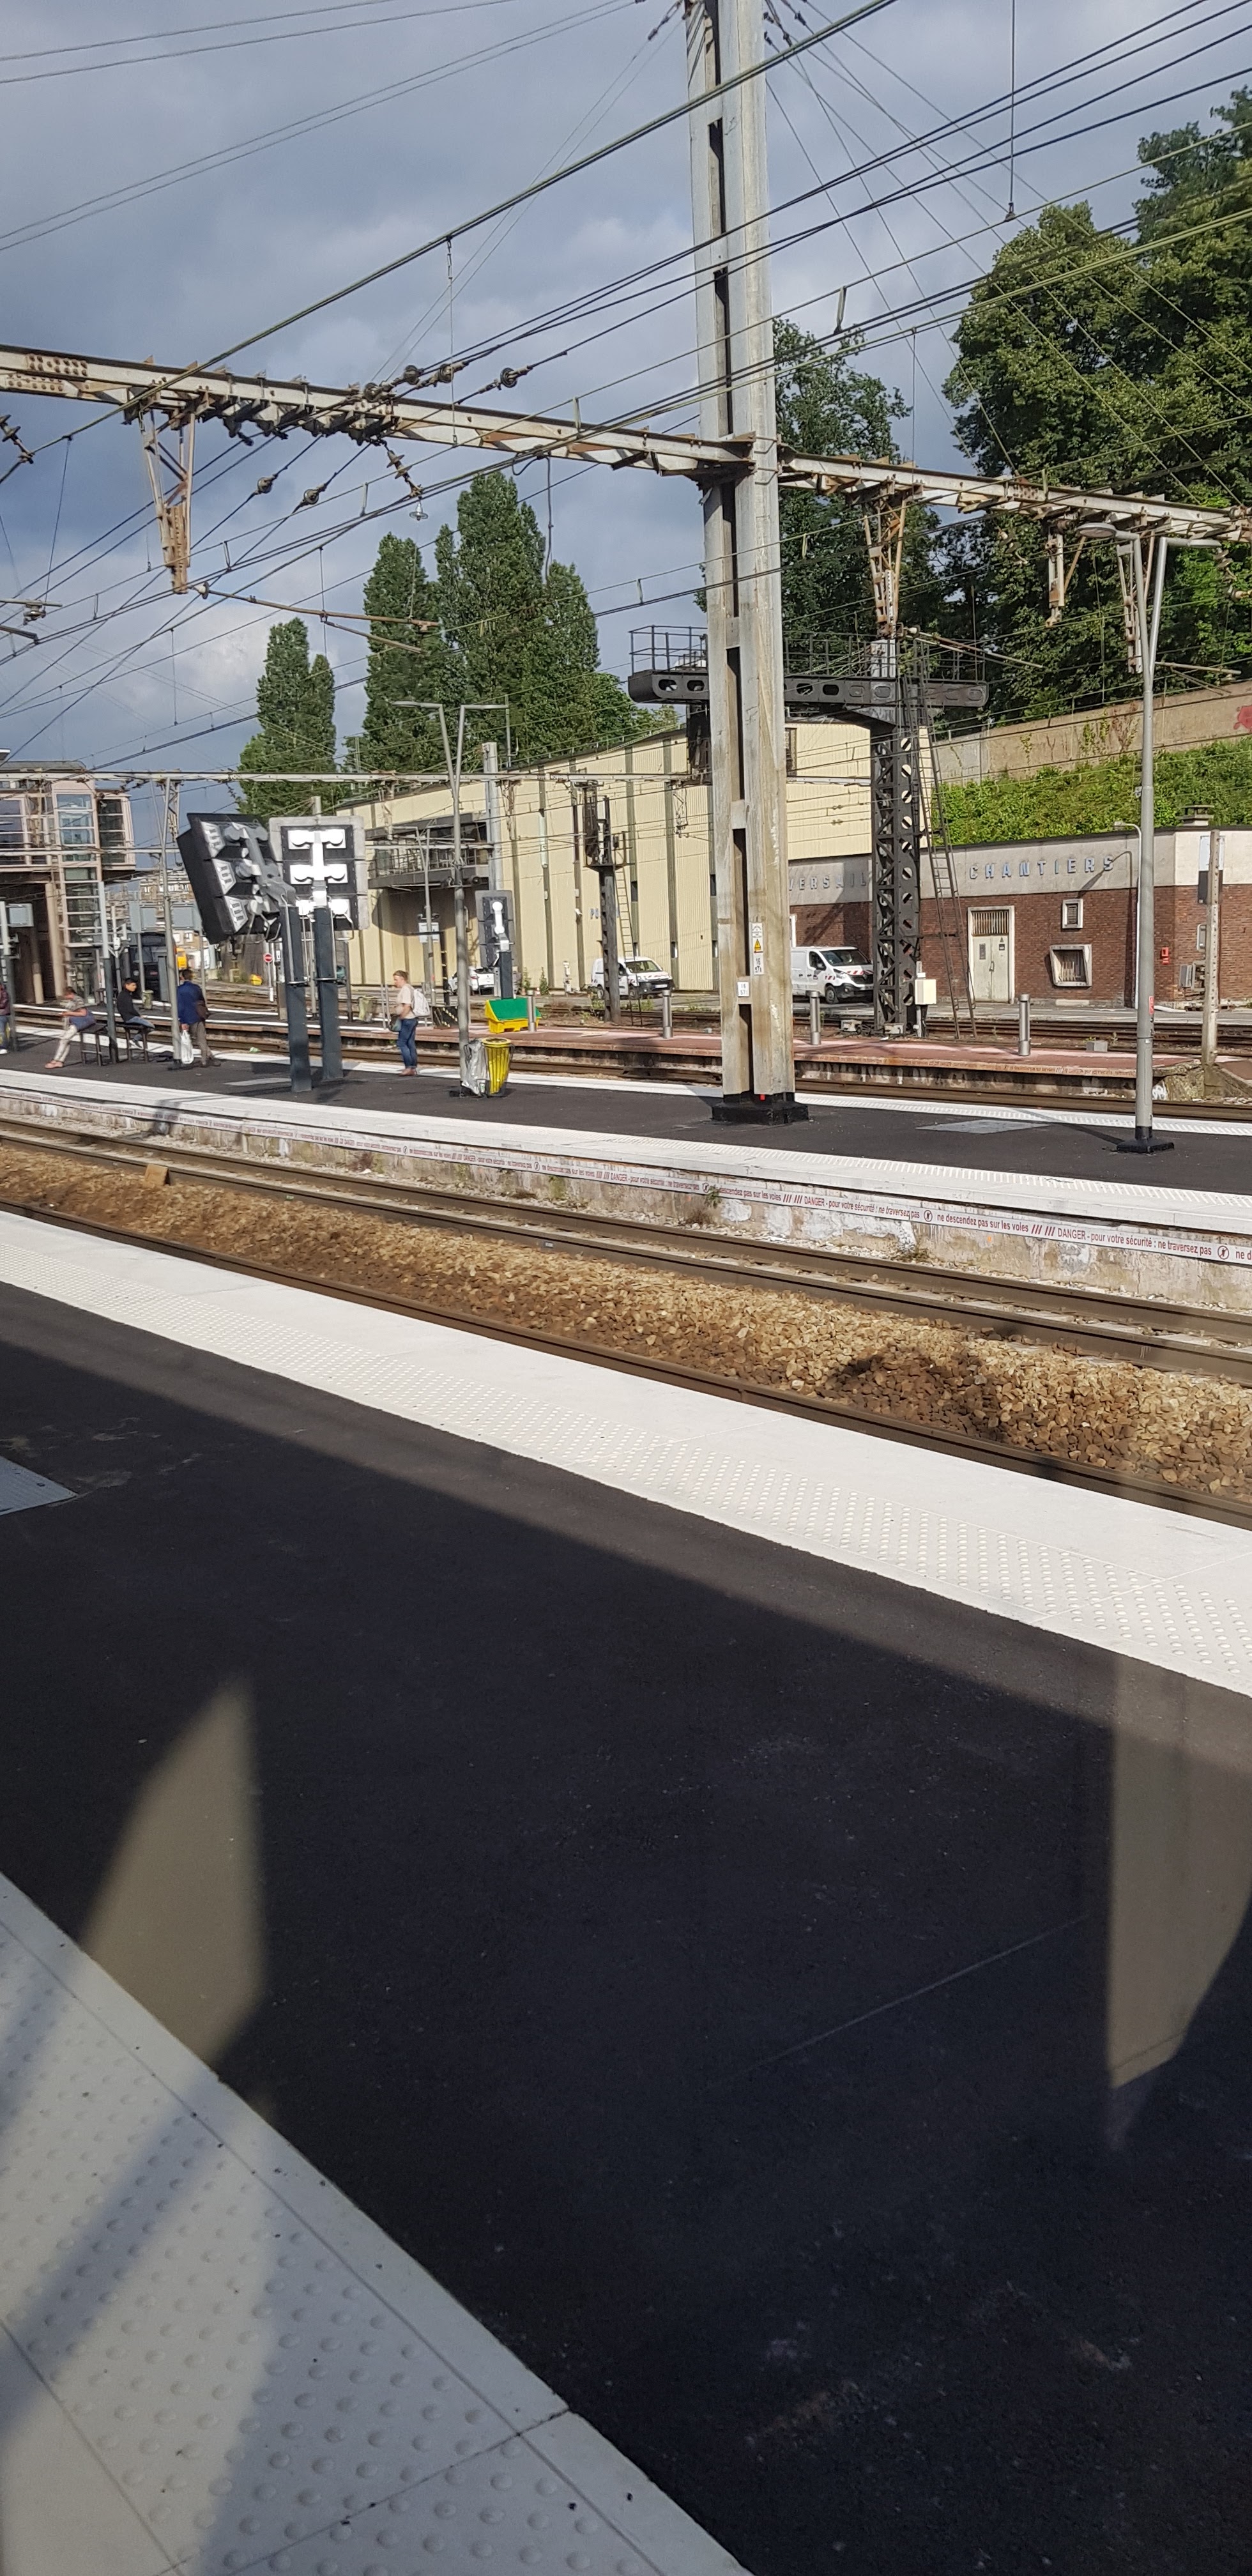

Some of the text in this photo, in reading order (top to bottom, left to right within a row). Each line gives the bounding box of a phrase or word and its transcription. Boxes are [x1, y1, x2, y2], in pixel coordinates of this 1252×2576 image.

[970, 855, 1113, 879] CHANTIERS
[804, 1195, 825, 1206] DANGER
[946, 1214, 977, 1225] descendez
[978, 1219, 988, 1228] pas
[1001, 1220, 1010, 1230] les
[1012, 1222, 1028, 1232] voies
[1057, 1228, 1086, 1239] DANGER
[1091, 1233, 1106, 1243] pour
[1107, 1234, 1124, 1244] votre
[1126, 1235, 1152, 1247] sécurité
[1157, 1241, 1166, 1249] ne
[1168, 1240, 1198, 1254] traversez
[1200, 1246, 1212, 1256] pas
[1235, 1250, 1245, 1260] ne
